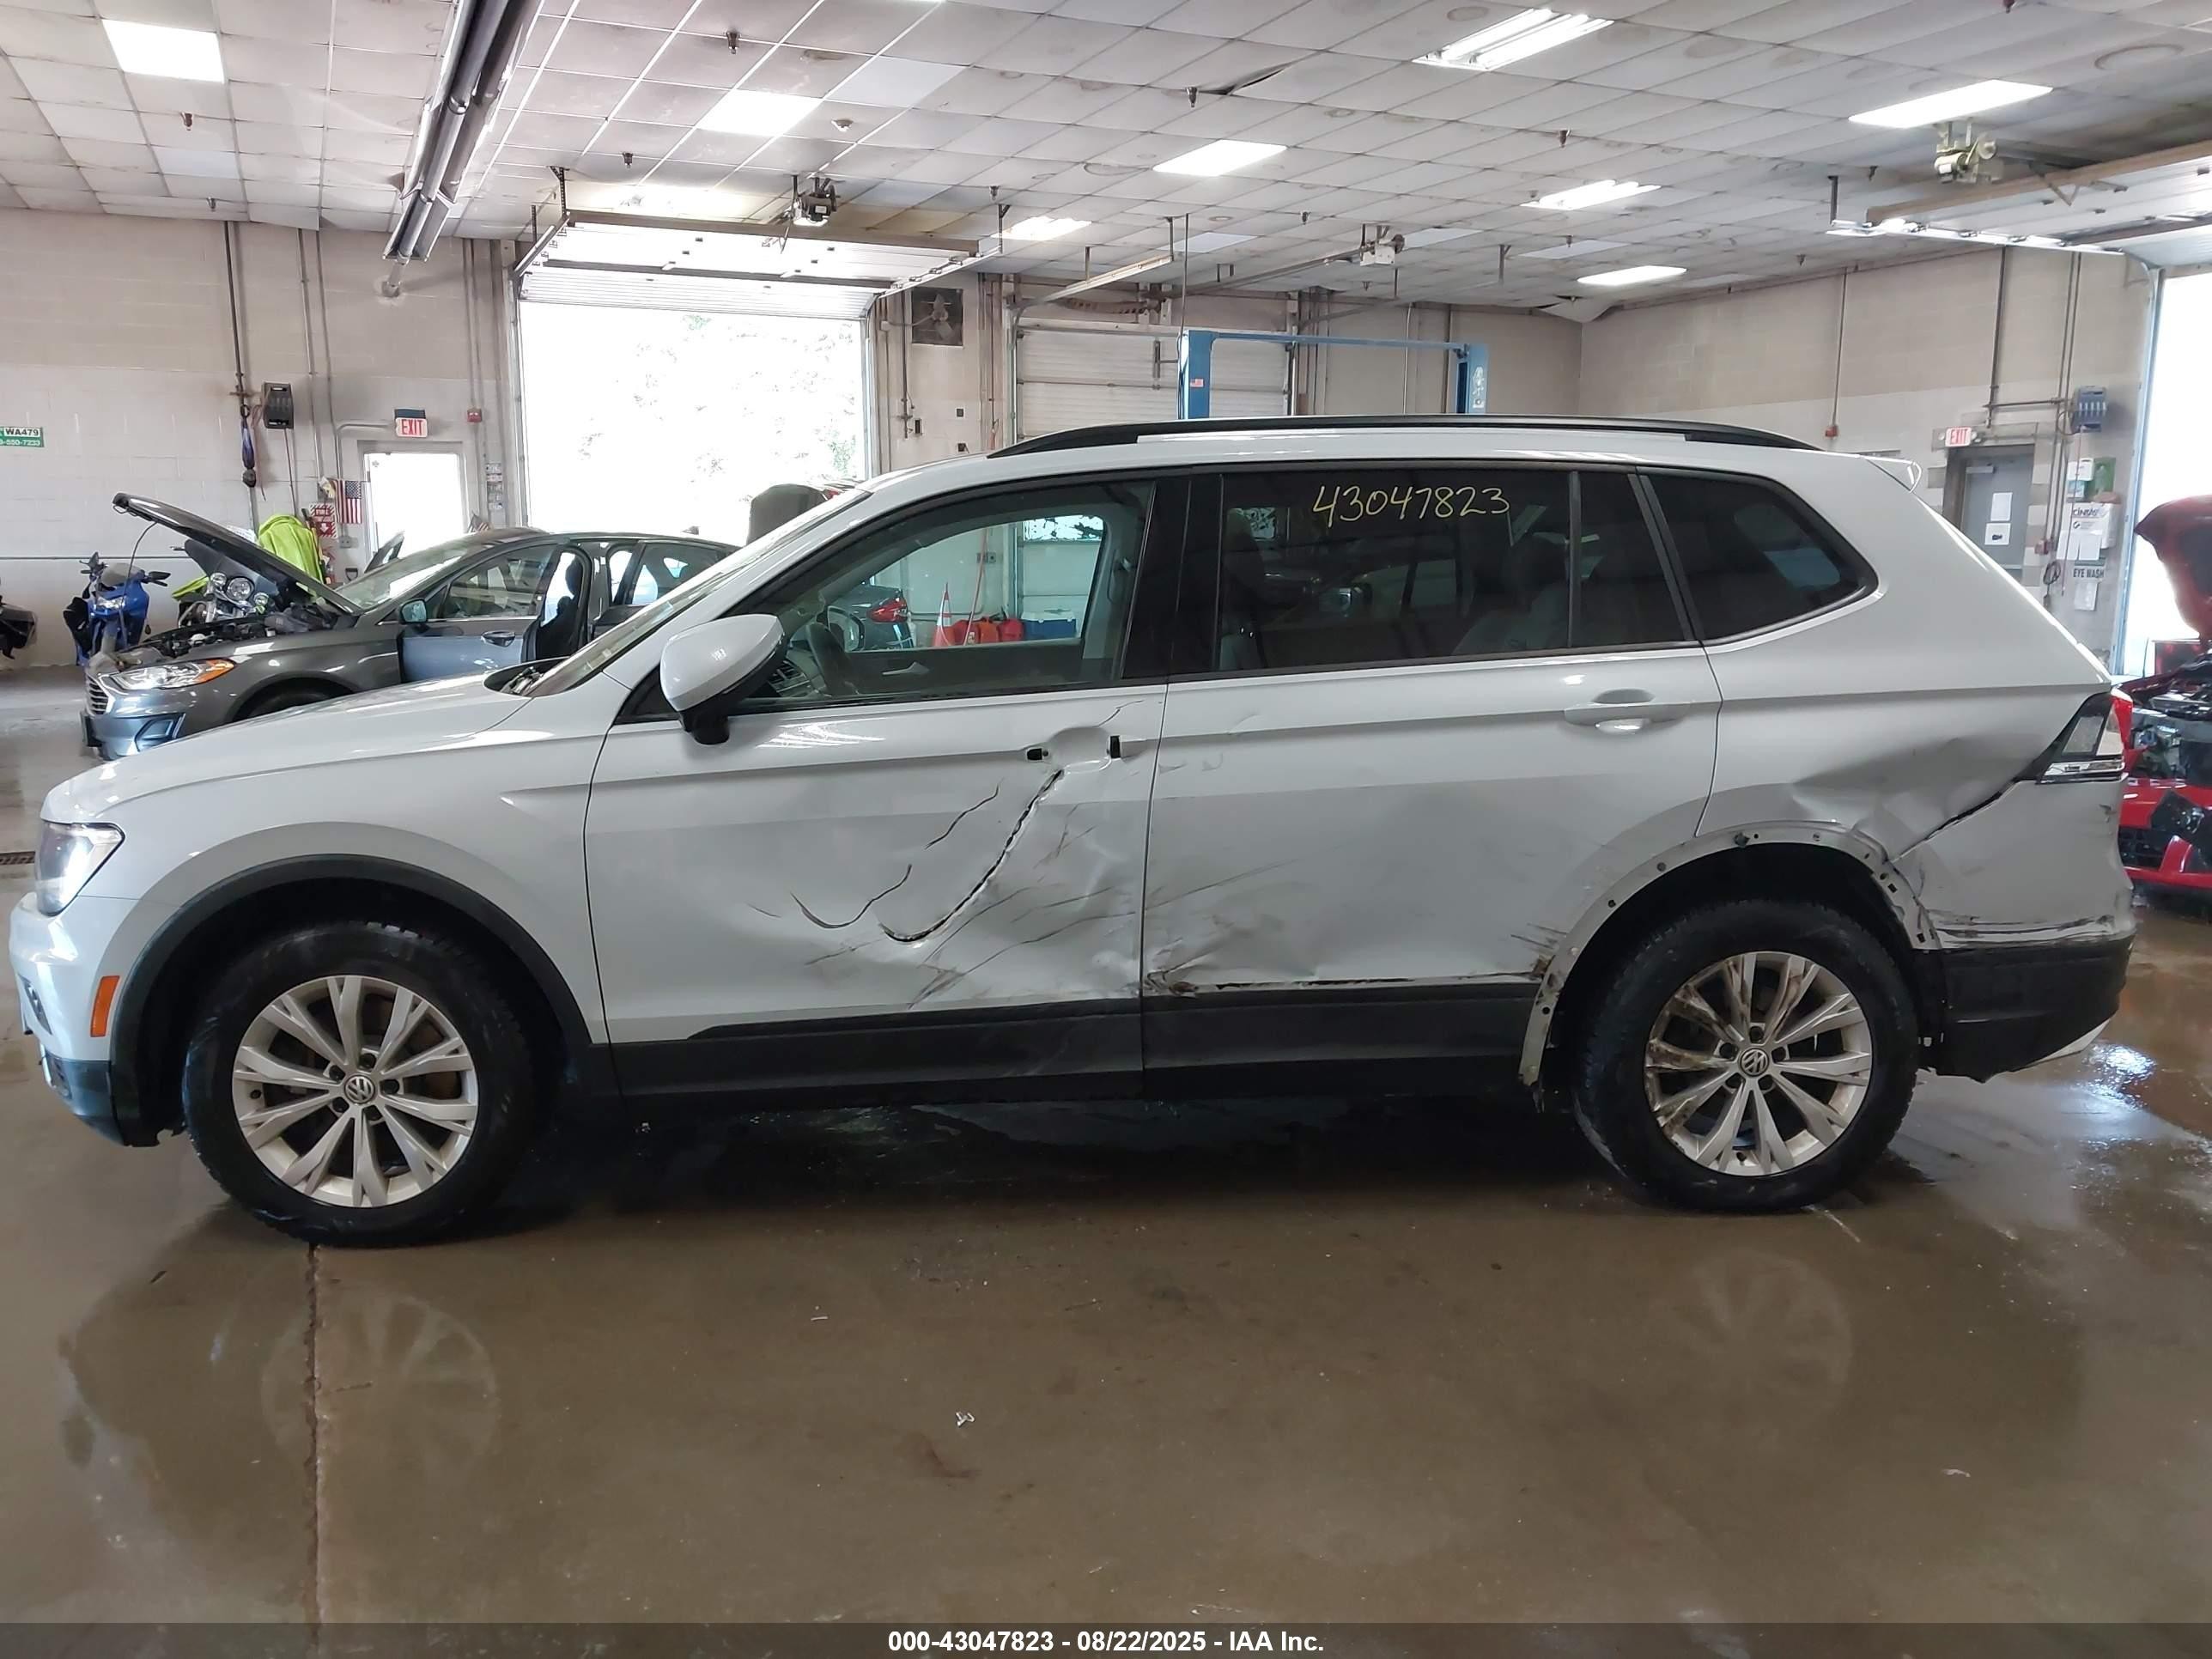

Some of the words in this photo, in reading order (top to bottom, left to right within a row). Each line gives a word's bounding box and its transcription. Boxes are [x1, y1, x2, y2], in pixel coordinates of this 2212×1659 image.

[401, 419, 423, 436] EXIT
[1950, 428, 1969, 445] EXIT
[1313, 485, 1510, 528] 43047823
[2073, 568, 2085, 578] EYE
[2086, 568, 2105, 579] WASH
